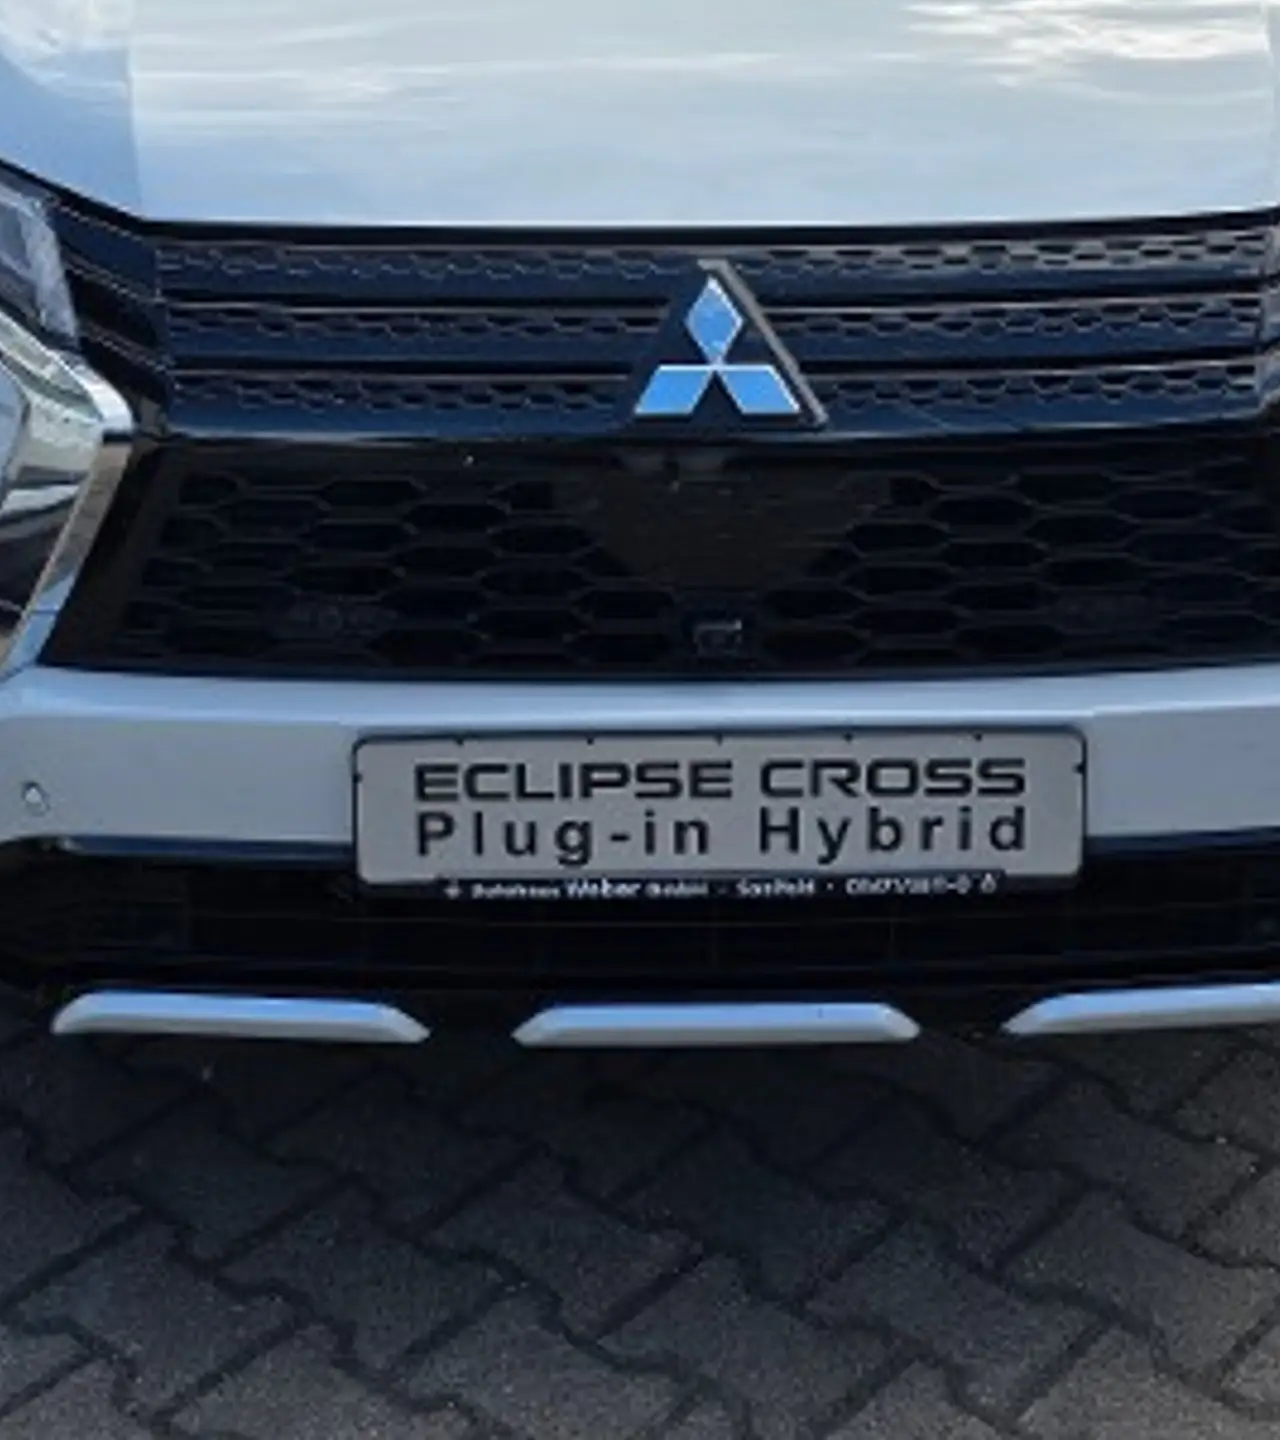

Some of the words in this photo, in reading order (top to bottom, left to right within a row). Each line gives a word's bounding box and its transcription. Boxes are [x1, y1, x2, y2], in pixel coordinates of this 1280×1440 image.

[416, 761, 732, 801] ECLIPSE
[760, 759, 1025, 797] CROSS
[416, 810, 710, 865] Plug-in
[759, 806, 1025, 863] Hybrid
